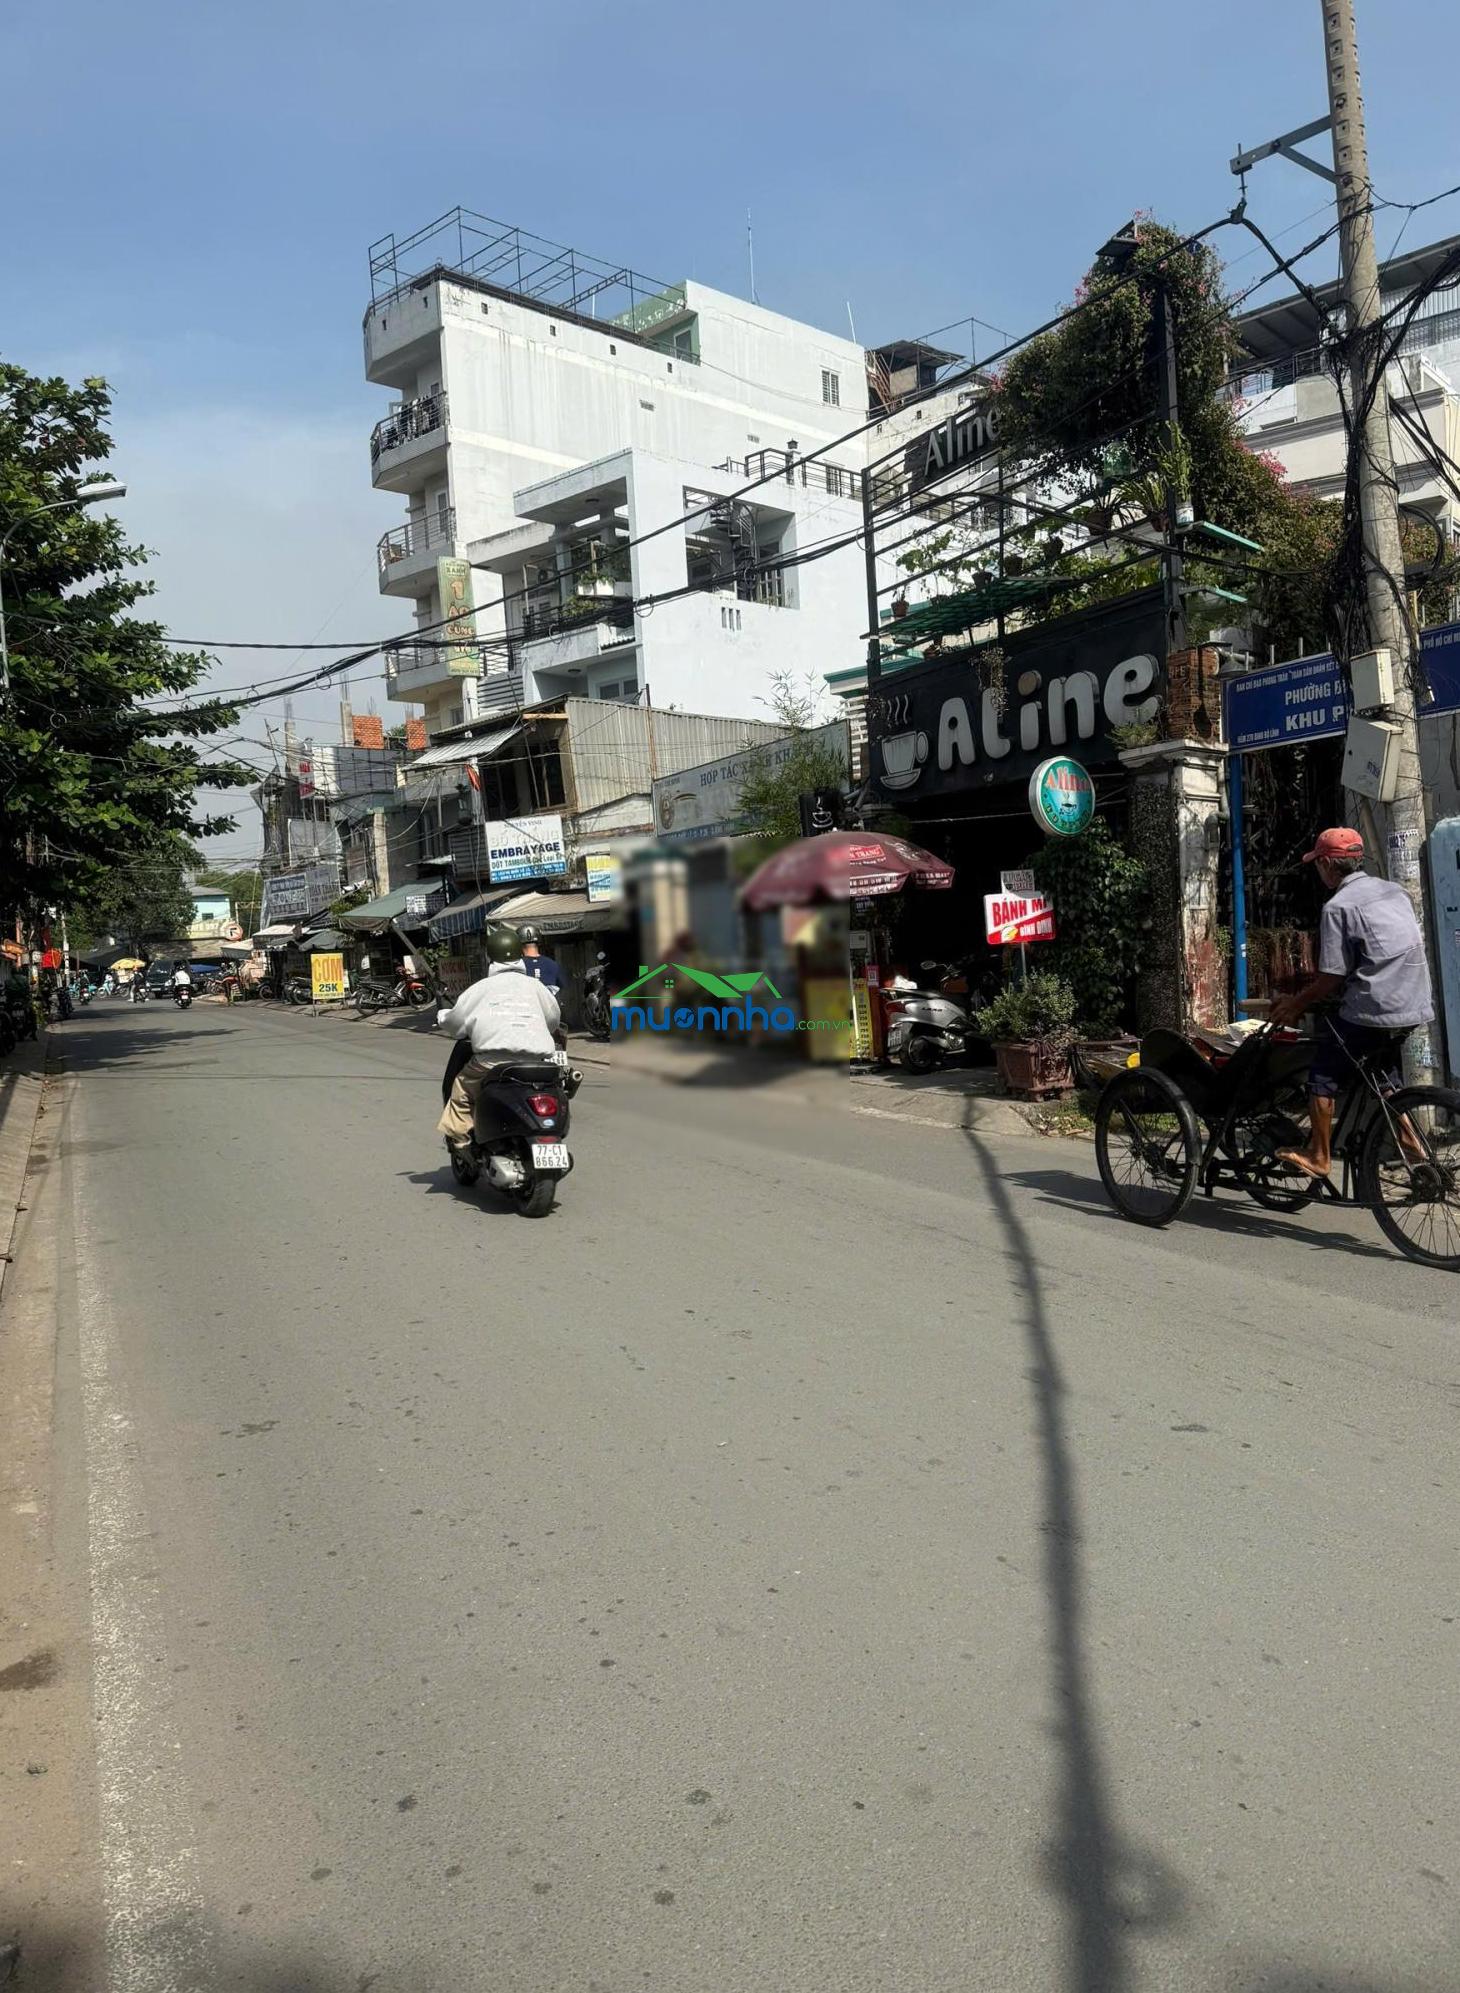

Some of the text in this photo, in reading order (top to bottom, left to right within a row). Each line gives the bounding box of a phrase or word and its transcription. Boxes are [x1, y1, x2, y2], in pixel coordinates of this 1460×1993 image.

[1285, 682, 1331, 706] PHƯỜNG
[1285, 708, 1326, 732] KHU
[490, 842, 561, 859] EMBRAYAGE
[992, 898, 1028, 927] BÁNH
[313, 956, 342, 982] CƠM
[319, 983, 338, 993] 25K
